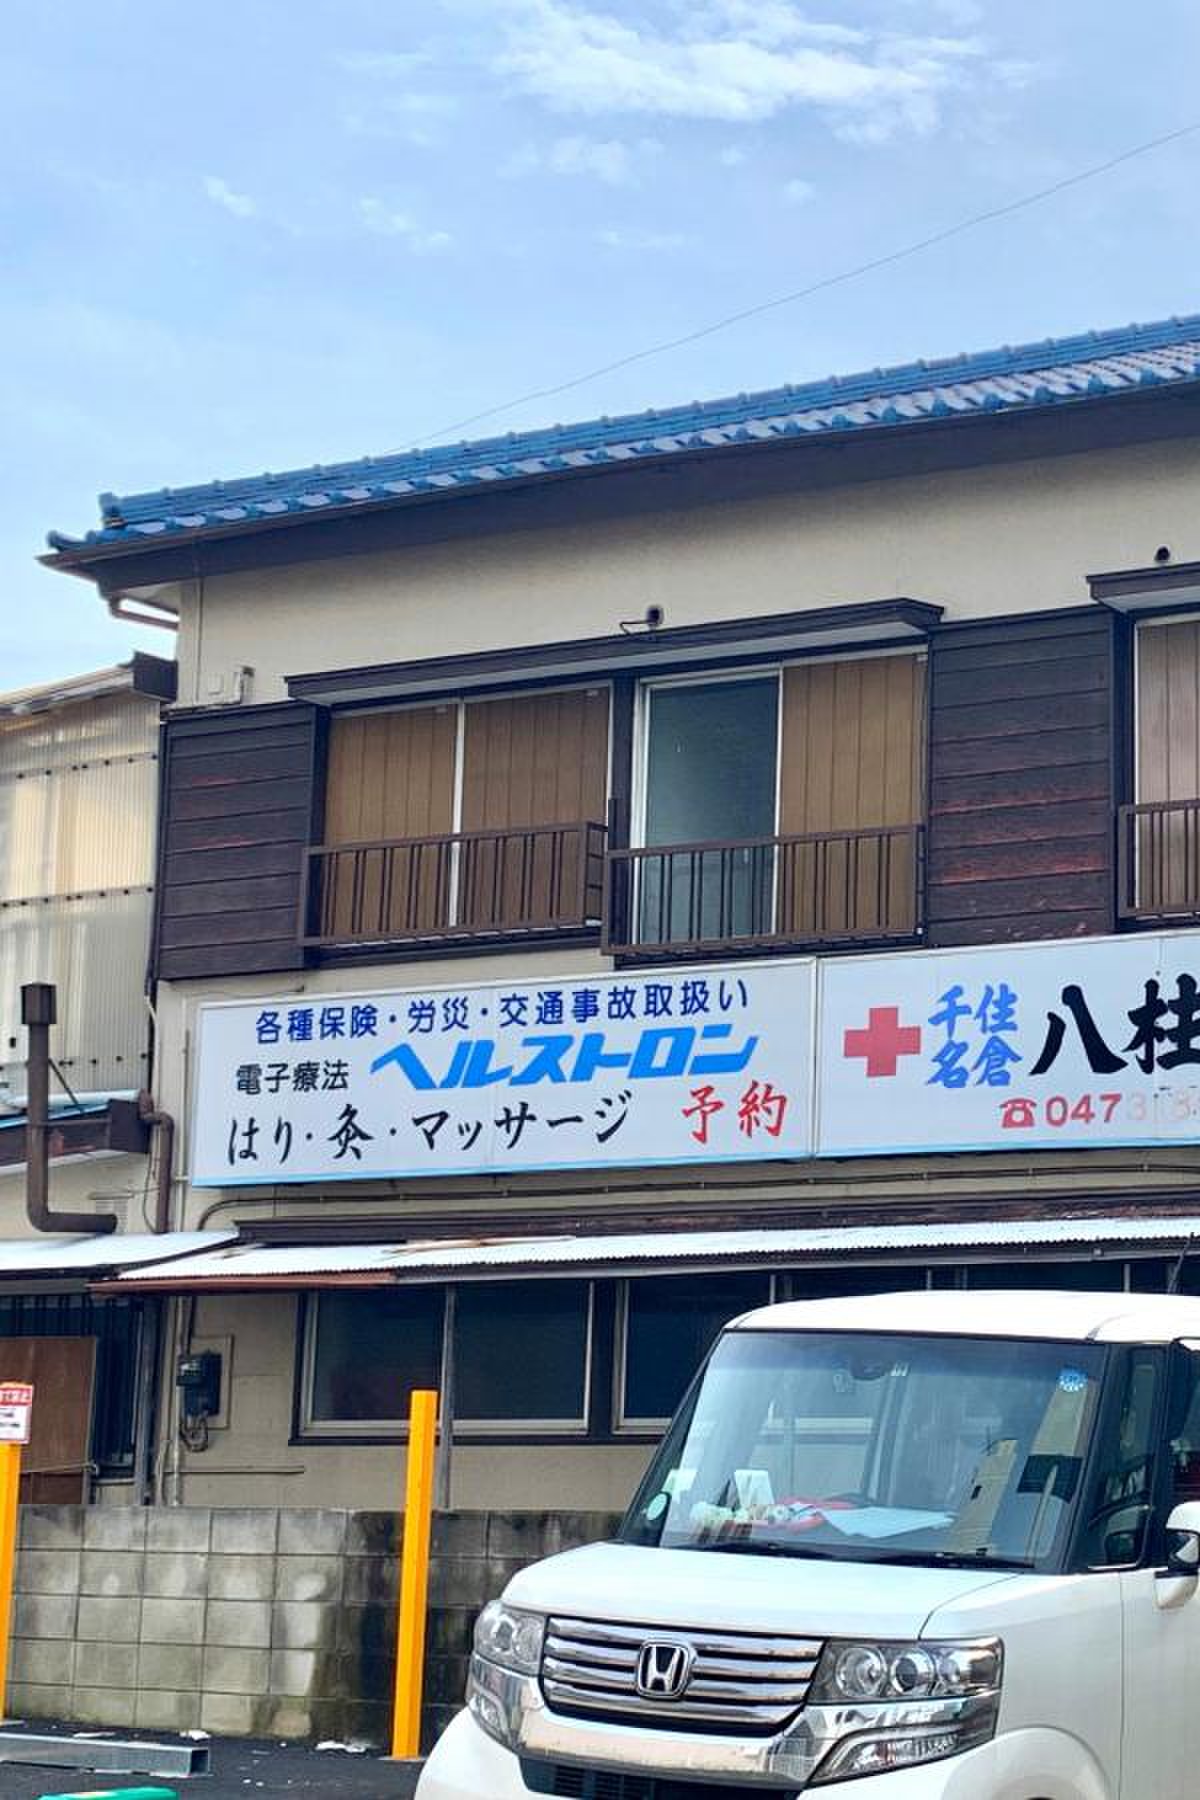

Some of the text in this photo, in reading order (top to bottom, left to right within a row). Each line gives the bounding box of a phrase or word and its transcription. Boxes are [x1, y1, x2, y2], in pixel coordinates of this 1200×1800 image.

[256, 979, 748, 1044] 各種保険・労災・交通事故取扱い
[236, 1060, 349, 1095] 電子療法
[370, 1024, 759, 1091] ヘルストロン
[925, 1036, 1022, 1088] 名倉
[228, 1089, 632, 1165] はり・灸・マッサージ
[681, 1080, 788, 1144] 予約
